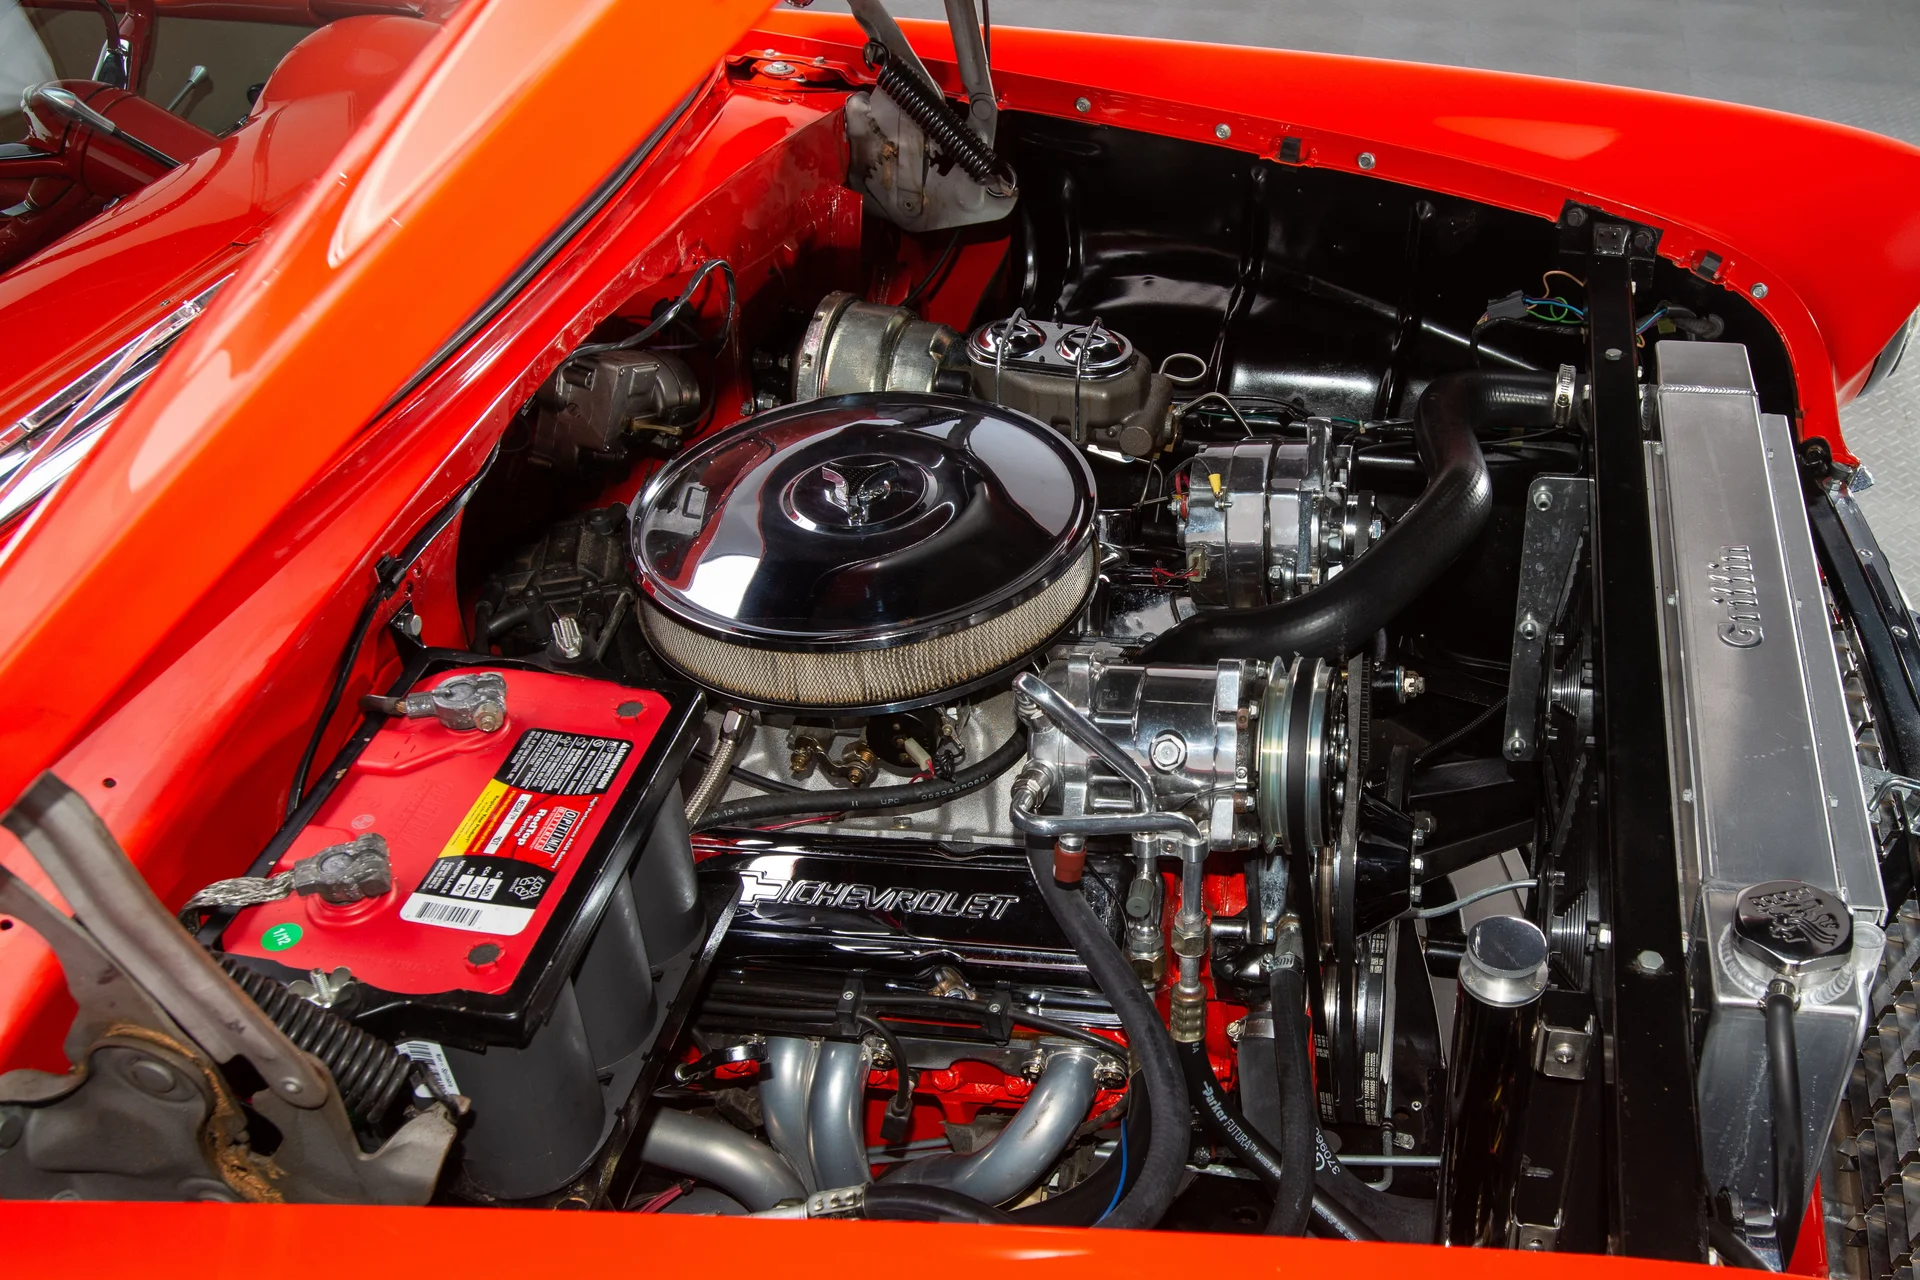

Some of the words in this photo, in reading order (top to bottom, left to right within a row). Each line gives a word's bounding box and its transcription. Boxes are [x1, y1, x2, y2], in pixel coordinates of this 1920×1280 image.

[1708, 545, 1765, 649] Griffin
[512, 814, 533, 836] Starting
[514, 809, 547, 845] RedTop
[534, 808, 565, 849] BATTERIES
[542, 810, 578, 852] OPTIMA
[789, 880, 1020, 921] CHEVROLET
[273, 927, 292, 946] 1/12
[440, 1067, 454, 1089] Spillable
[1203, 1081, 1228, 1122] Parker
